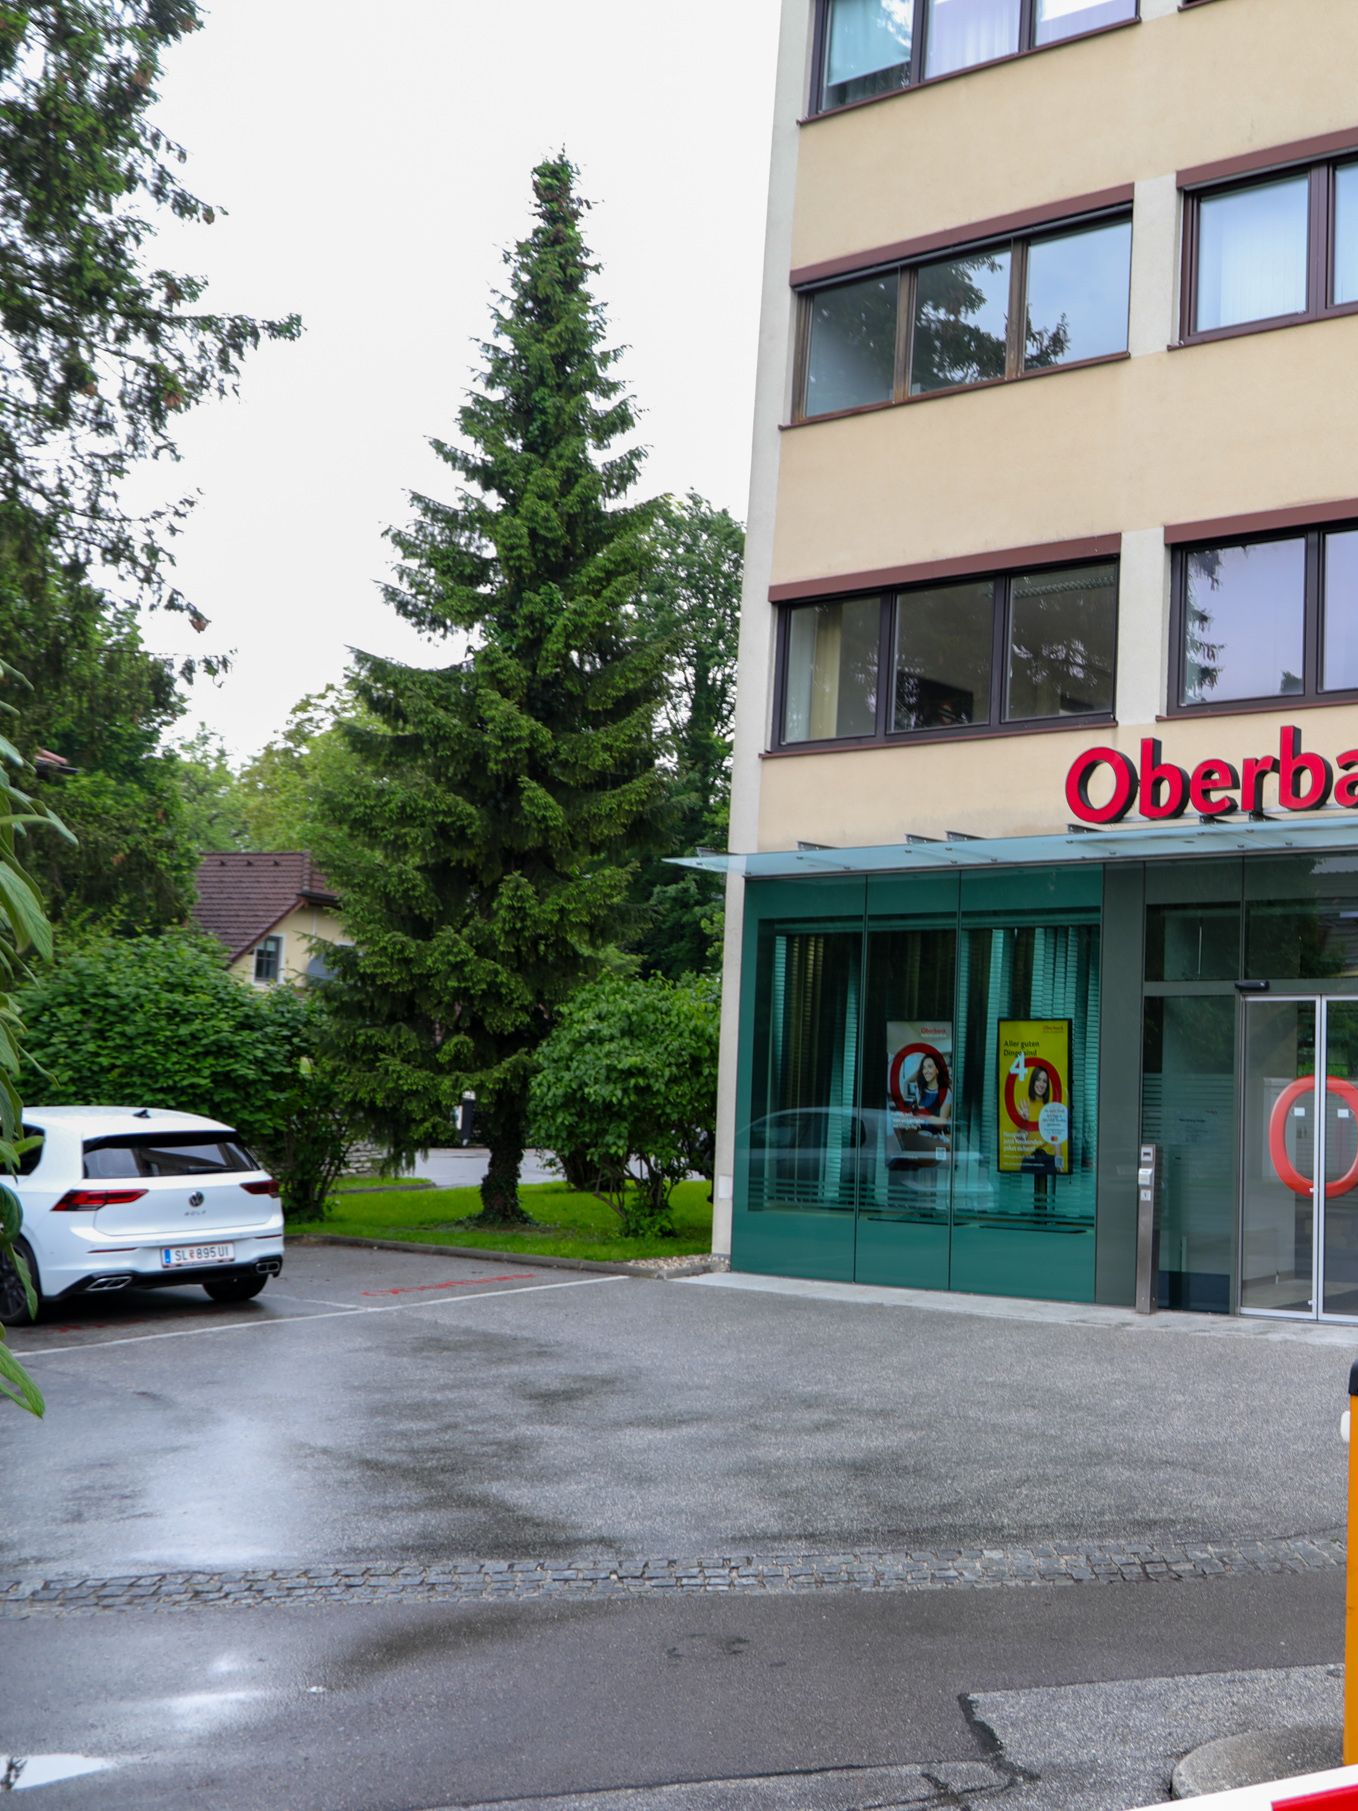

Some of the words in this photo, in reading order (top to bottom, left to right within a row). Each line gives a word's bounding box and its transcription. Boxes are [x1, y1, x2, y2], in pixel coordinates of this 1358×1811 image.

[1021, 1040, 1040, 1049] guten
[1009, 1051, 1028, 1082] 4
[175, 1249, 188, 1261] SL
[196, 1247, 216, 1259] 895
